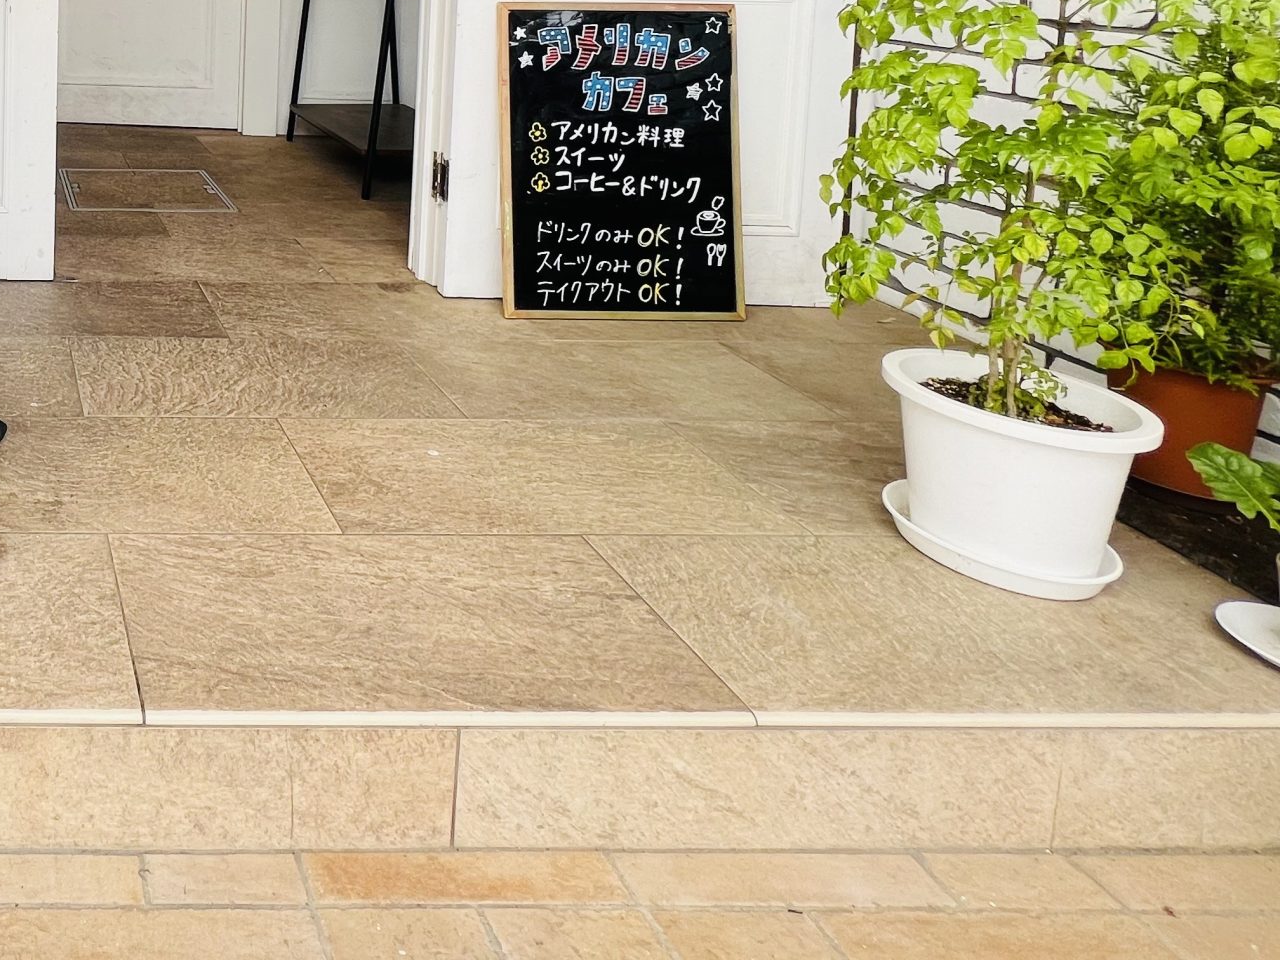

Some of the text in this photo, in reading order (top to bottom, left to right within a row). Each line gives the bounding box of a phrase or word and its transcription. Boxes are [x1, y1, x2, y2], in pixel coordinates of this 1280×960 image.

[537, 22, 711, 71] アメリカン
[581, 71, 669, 115] カフェ
[551, 121, 686, 149] アメリカン料理
[554, 146, 626, 171] スイーツ
